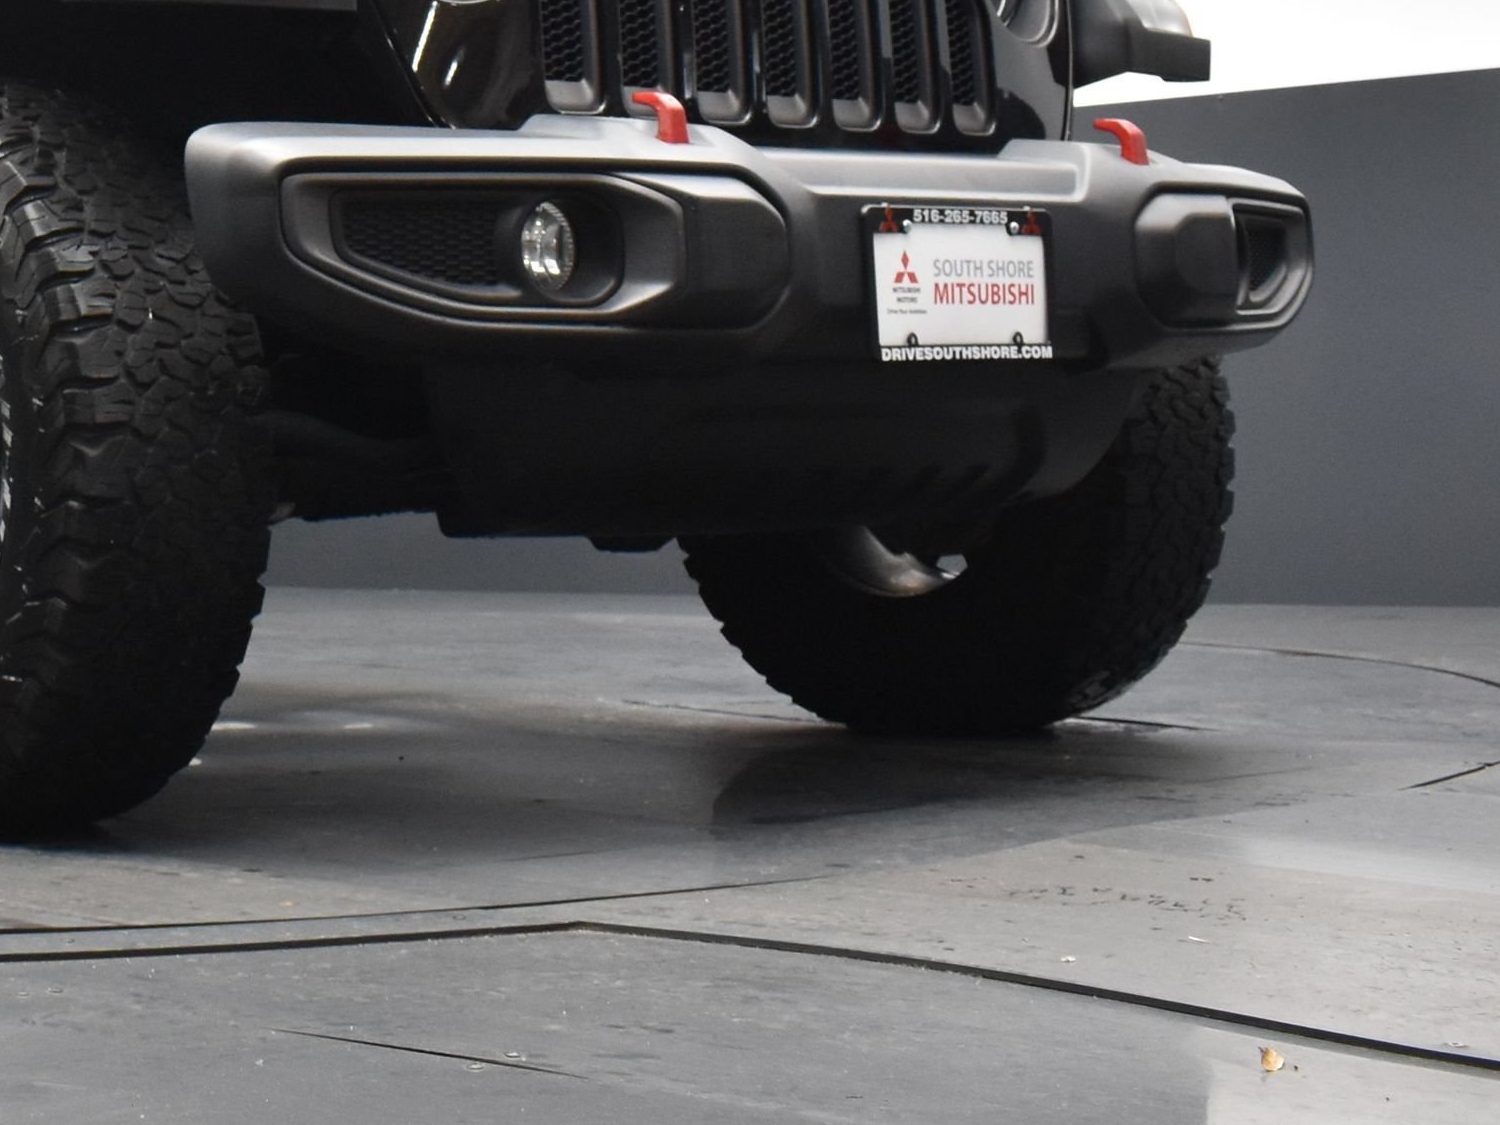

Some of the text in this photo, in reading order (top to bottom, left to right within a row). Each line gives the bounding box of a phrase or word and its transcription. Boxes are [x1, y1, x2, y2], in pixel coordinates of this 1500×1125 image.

[913, 209, 1008, 224] 516-265-7665
[933, 259, 1034, 278] SOUTH SHORE
[933, 282, 1035, 305] MITSUBISHI
[881, 346, 1053, 362] DRIVESOUTHSHORE.COM
